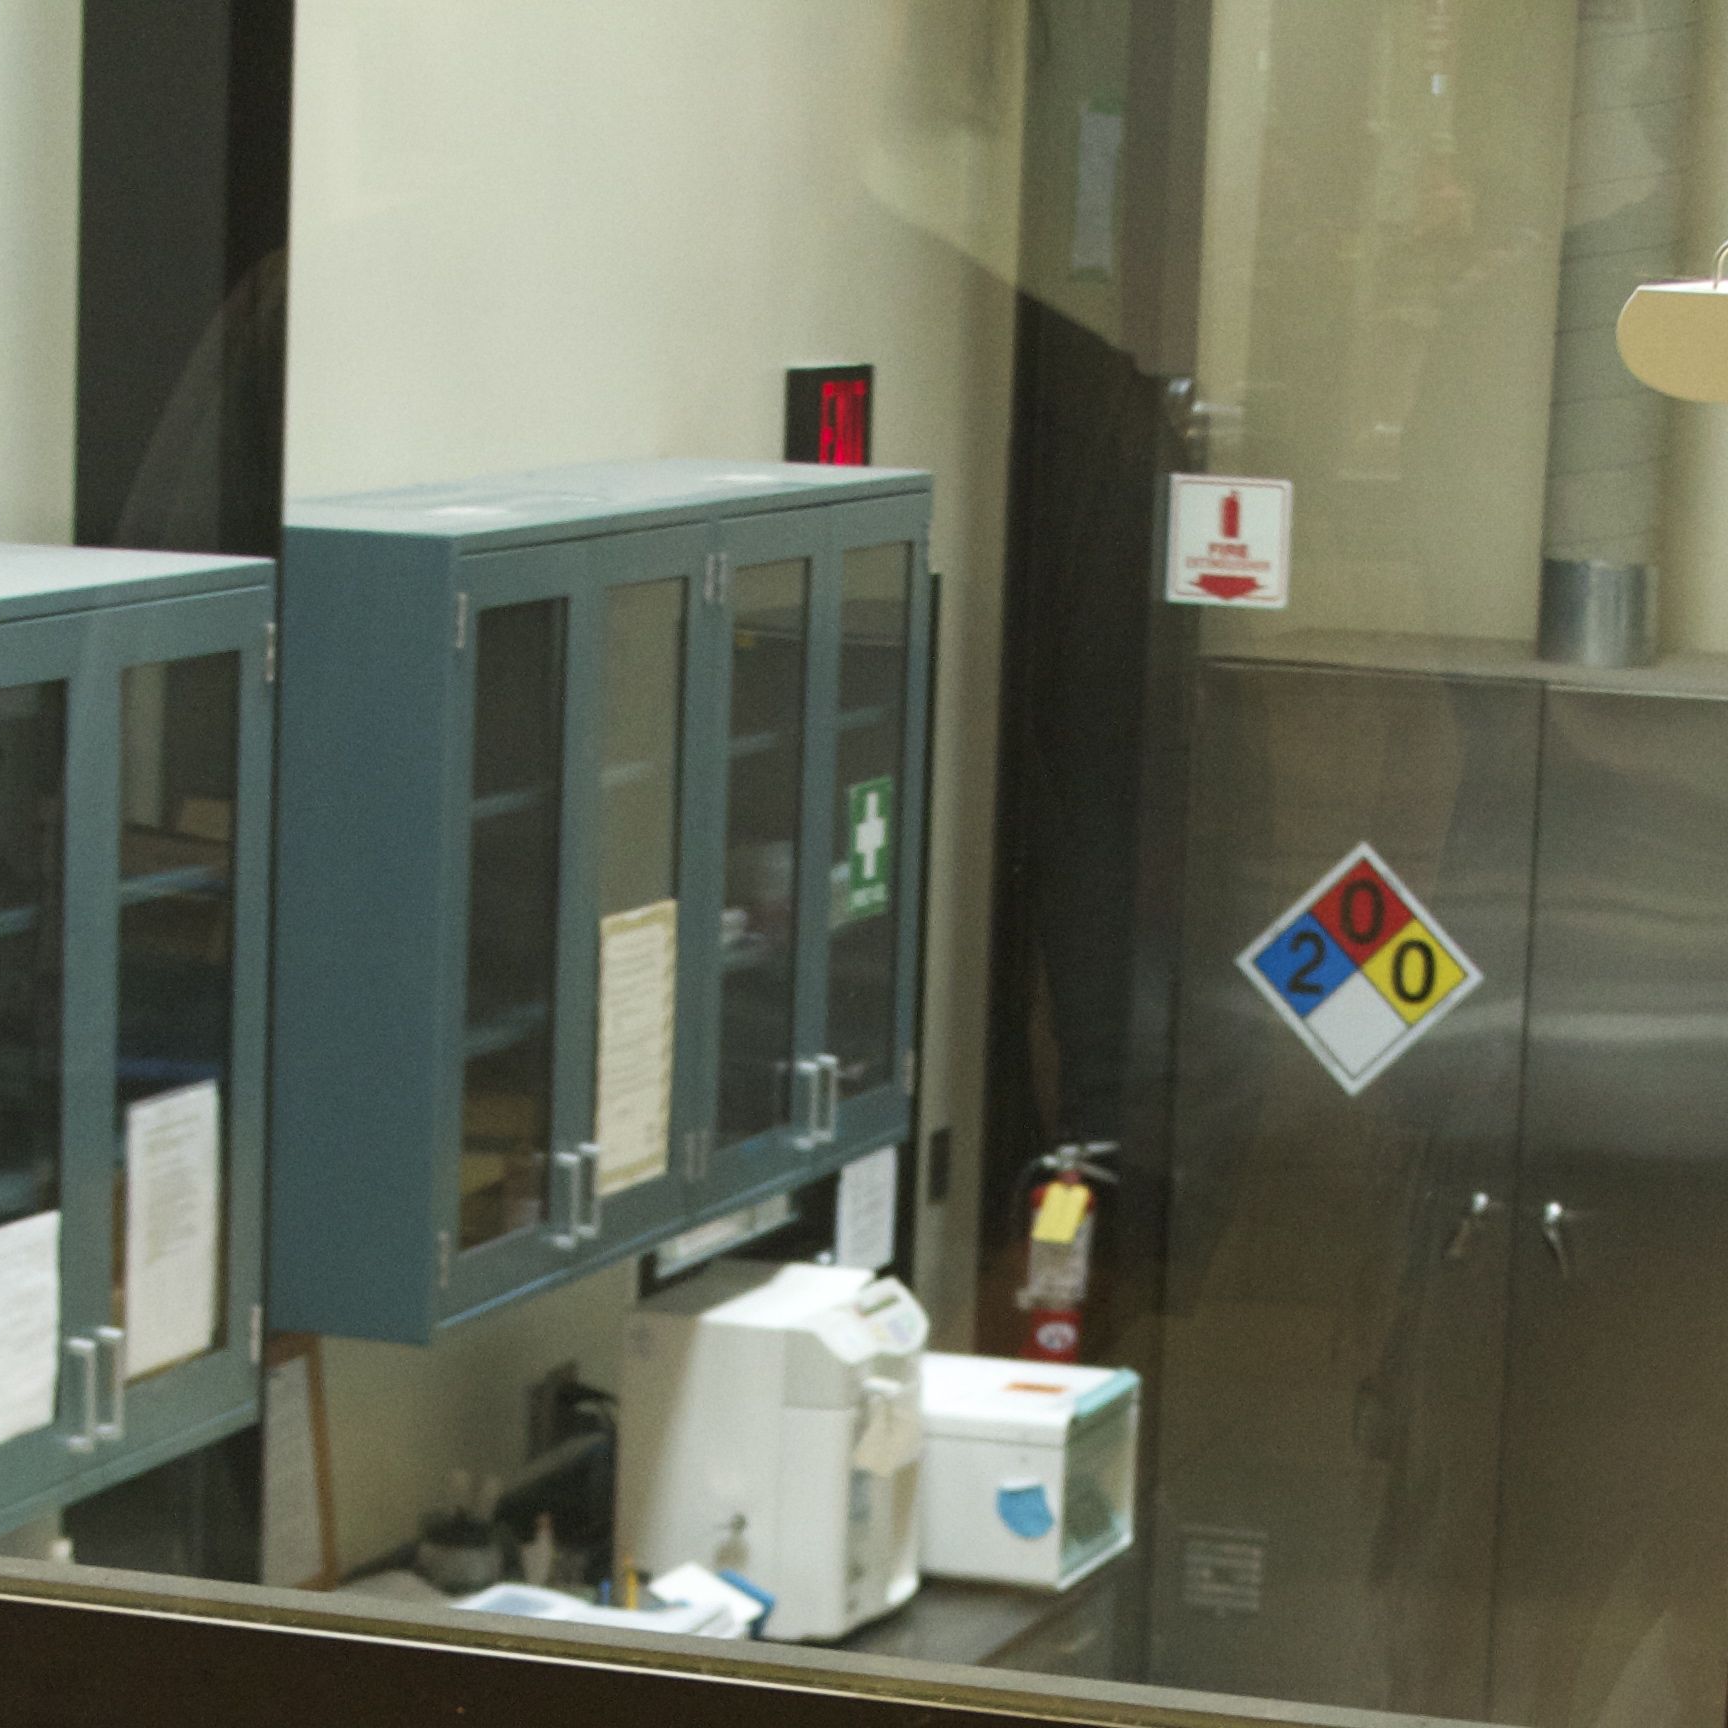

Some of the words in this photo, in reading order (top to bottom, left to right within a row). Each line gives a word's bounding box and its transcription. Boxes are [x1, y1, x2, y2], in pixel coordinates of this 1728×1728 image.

[1338, 879, 1385, 945] 0
[1286, 932, 1326, 998] 2
[1391, 938, 1437, 1005] 0
